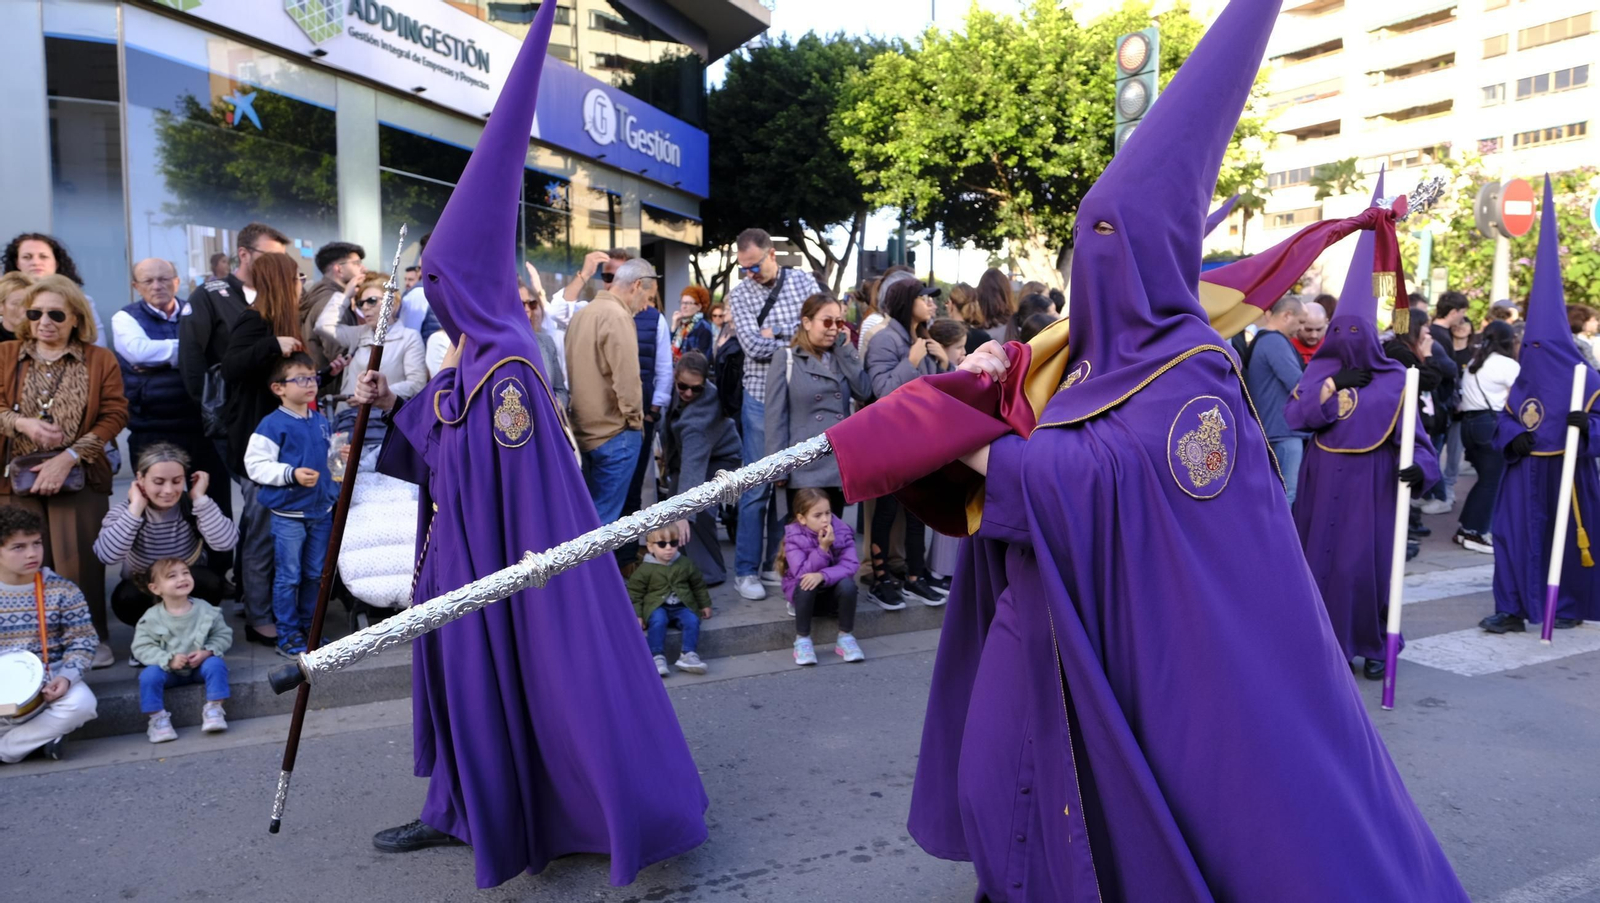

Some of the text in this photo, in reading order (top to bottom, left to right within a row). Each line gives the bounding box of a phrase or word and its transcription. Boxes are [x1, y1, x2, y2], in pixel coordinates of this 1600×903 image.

[348, 26, 380, 47] Gestión
[381, 39, 411, 60] Integral
[412, 53, 421, 64] de
[422, 56, 454, 77] Empresas
[460, 71, 490, 90] Proyectos
[616, 104, 681, 168] TGestión
